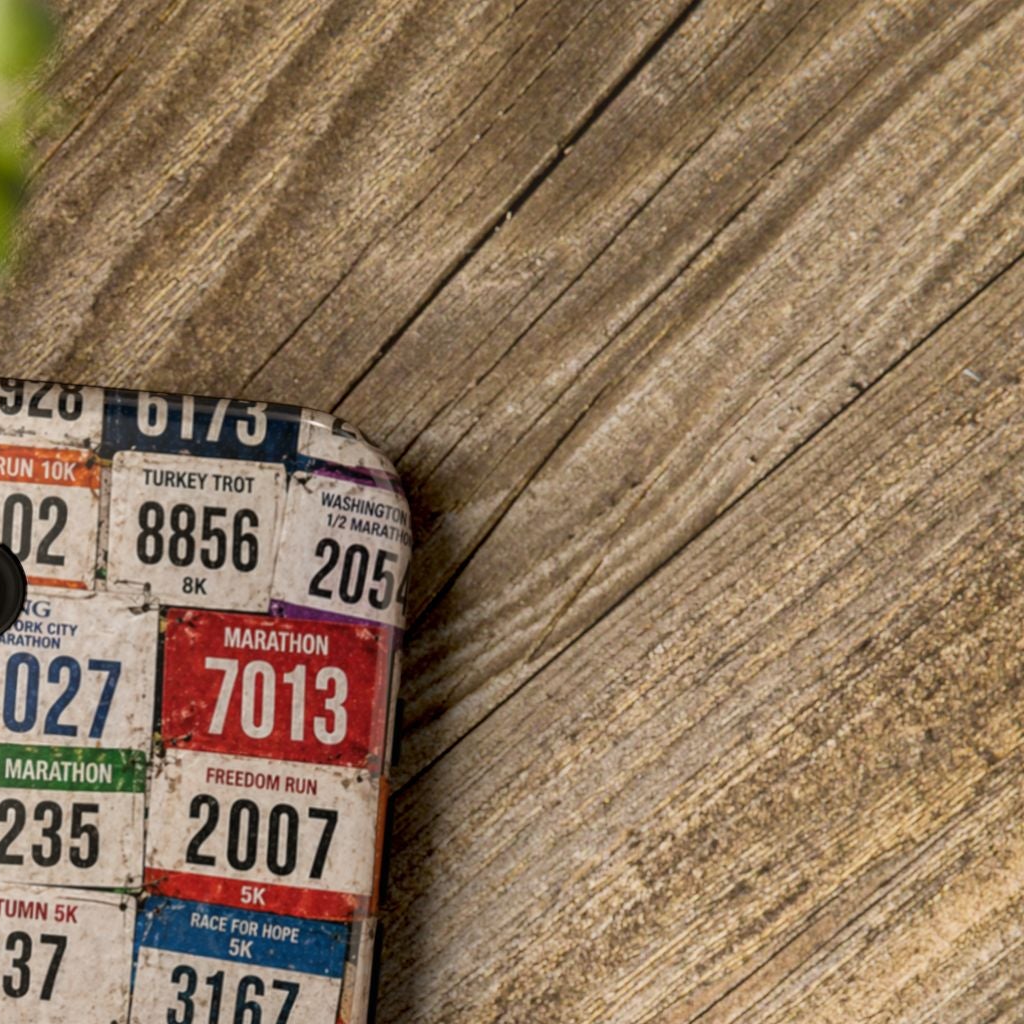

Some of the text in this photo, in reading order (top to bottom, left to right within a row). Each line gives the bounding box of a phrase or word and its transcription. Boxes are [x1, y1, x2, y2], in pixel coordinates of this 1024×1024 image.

[41, 460, 76, 481] 10K
[144, 469, 255, 493] TURKEY TROT
[322, 491, 408, 526] WASHINGTON
[327, 513, 347, 529] 1/2
[136, 501, 259, 573] 8856
[182, 577, 207, 595] 8K
[23, 600, 51, 618] NG
[13, 619, 78, 637] ORK CITY
[224, 627, 329, 656] MARATHON
[204, 656, 349, 745] 7013
[4, 758, 113, 785] MARATHON
[206, 767, 318, 796] FREEDOM RUN
[185, 794, 338, 880] 2007
[240, 886, 267, 905] 5K
[54, 904, 78, 924] 5K
[190, 912, 300, 944] RACE FOR HOPE
[228, 940, 253, 959] 5K
